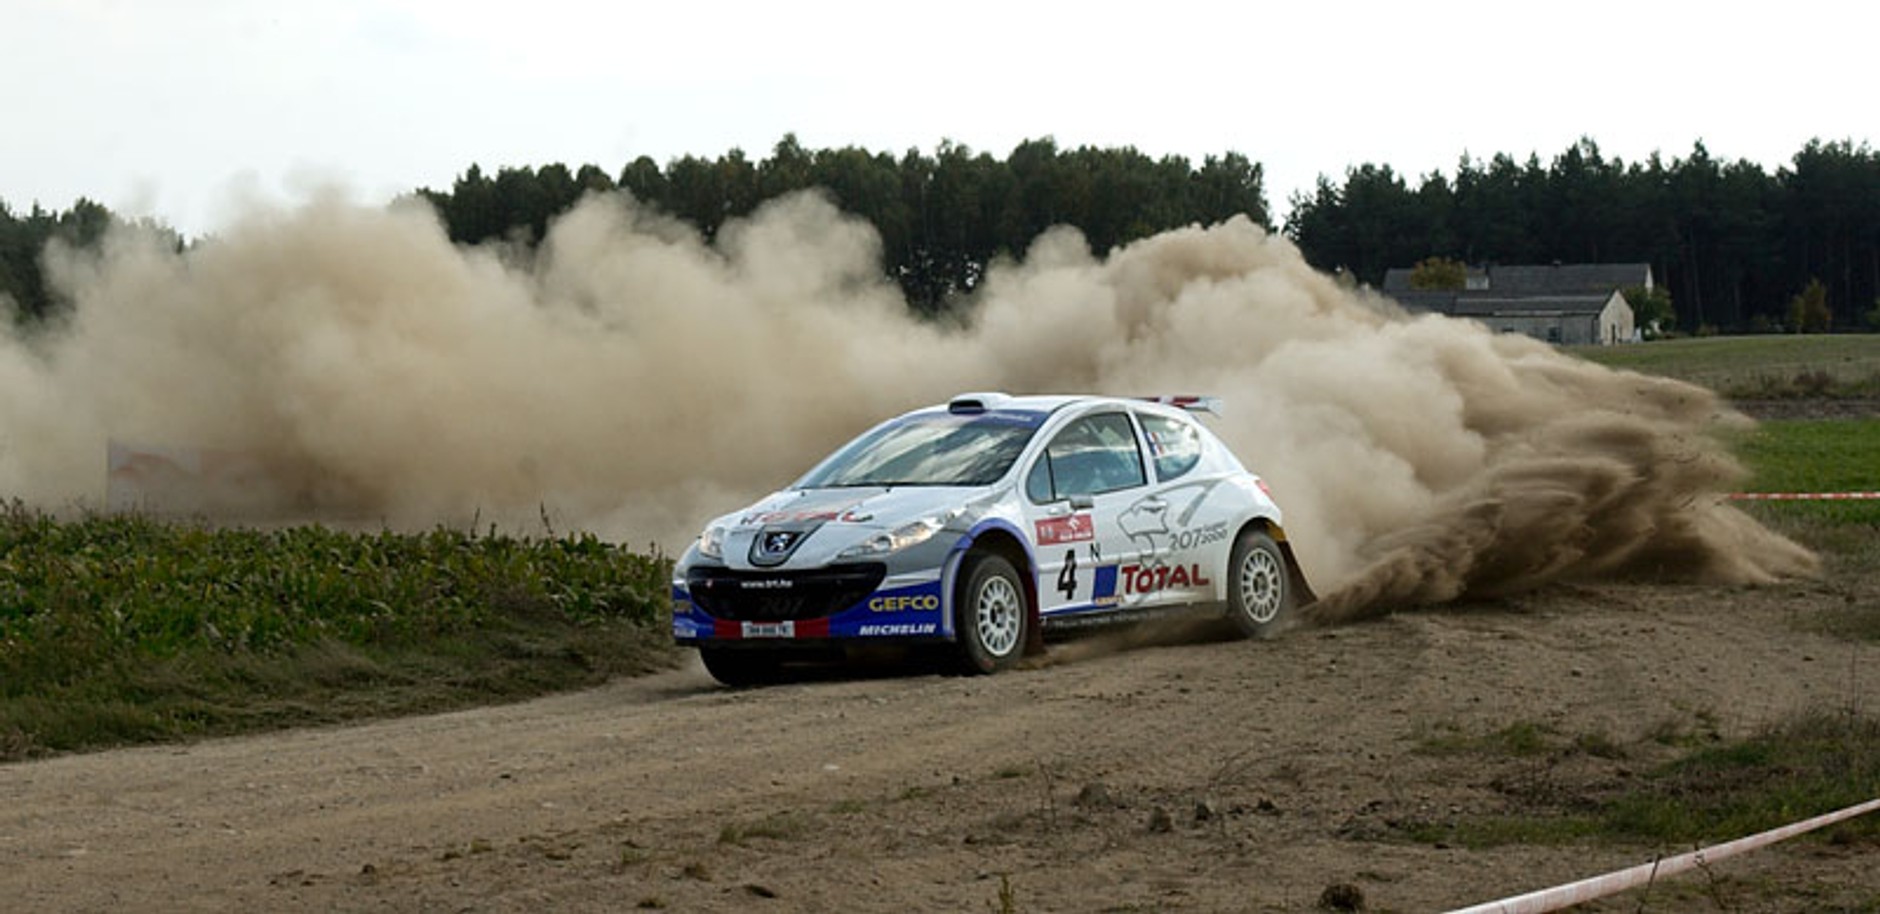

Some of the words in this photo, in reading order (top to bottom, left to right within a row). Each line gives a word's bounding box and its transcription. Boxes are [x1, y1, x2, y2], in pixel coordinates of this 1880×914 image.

[1169, 527, 1202, 551] 207
[1090, 542, 1101, 562] N
[1057, 549, 1077, 600] 4
[1121, 563, 1210, 595] TOTAL
[869, 595, 939, 612] GEFCO
[859, 623, 937, 636] MICHELIN
